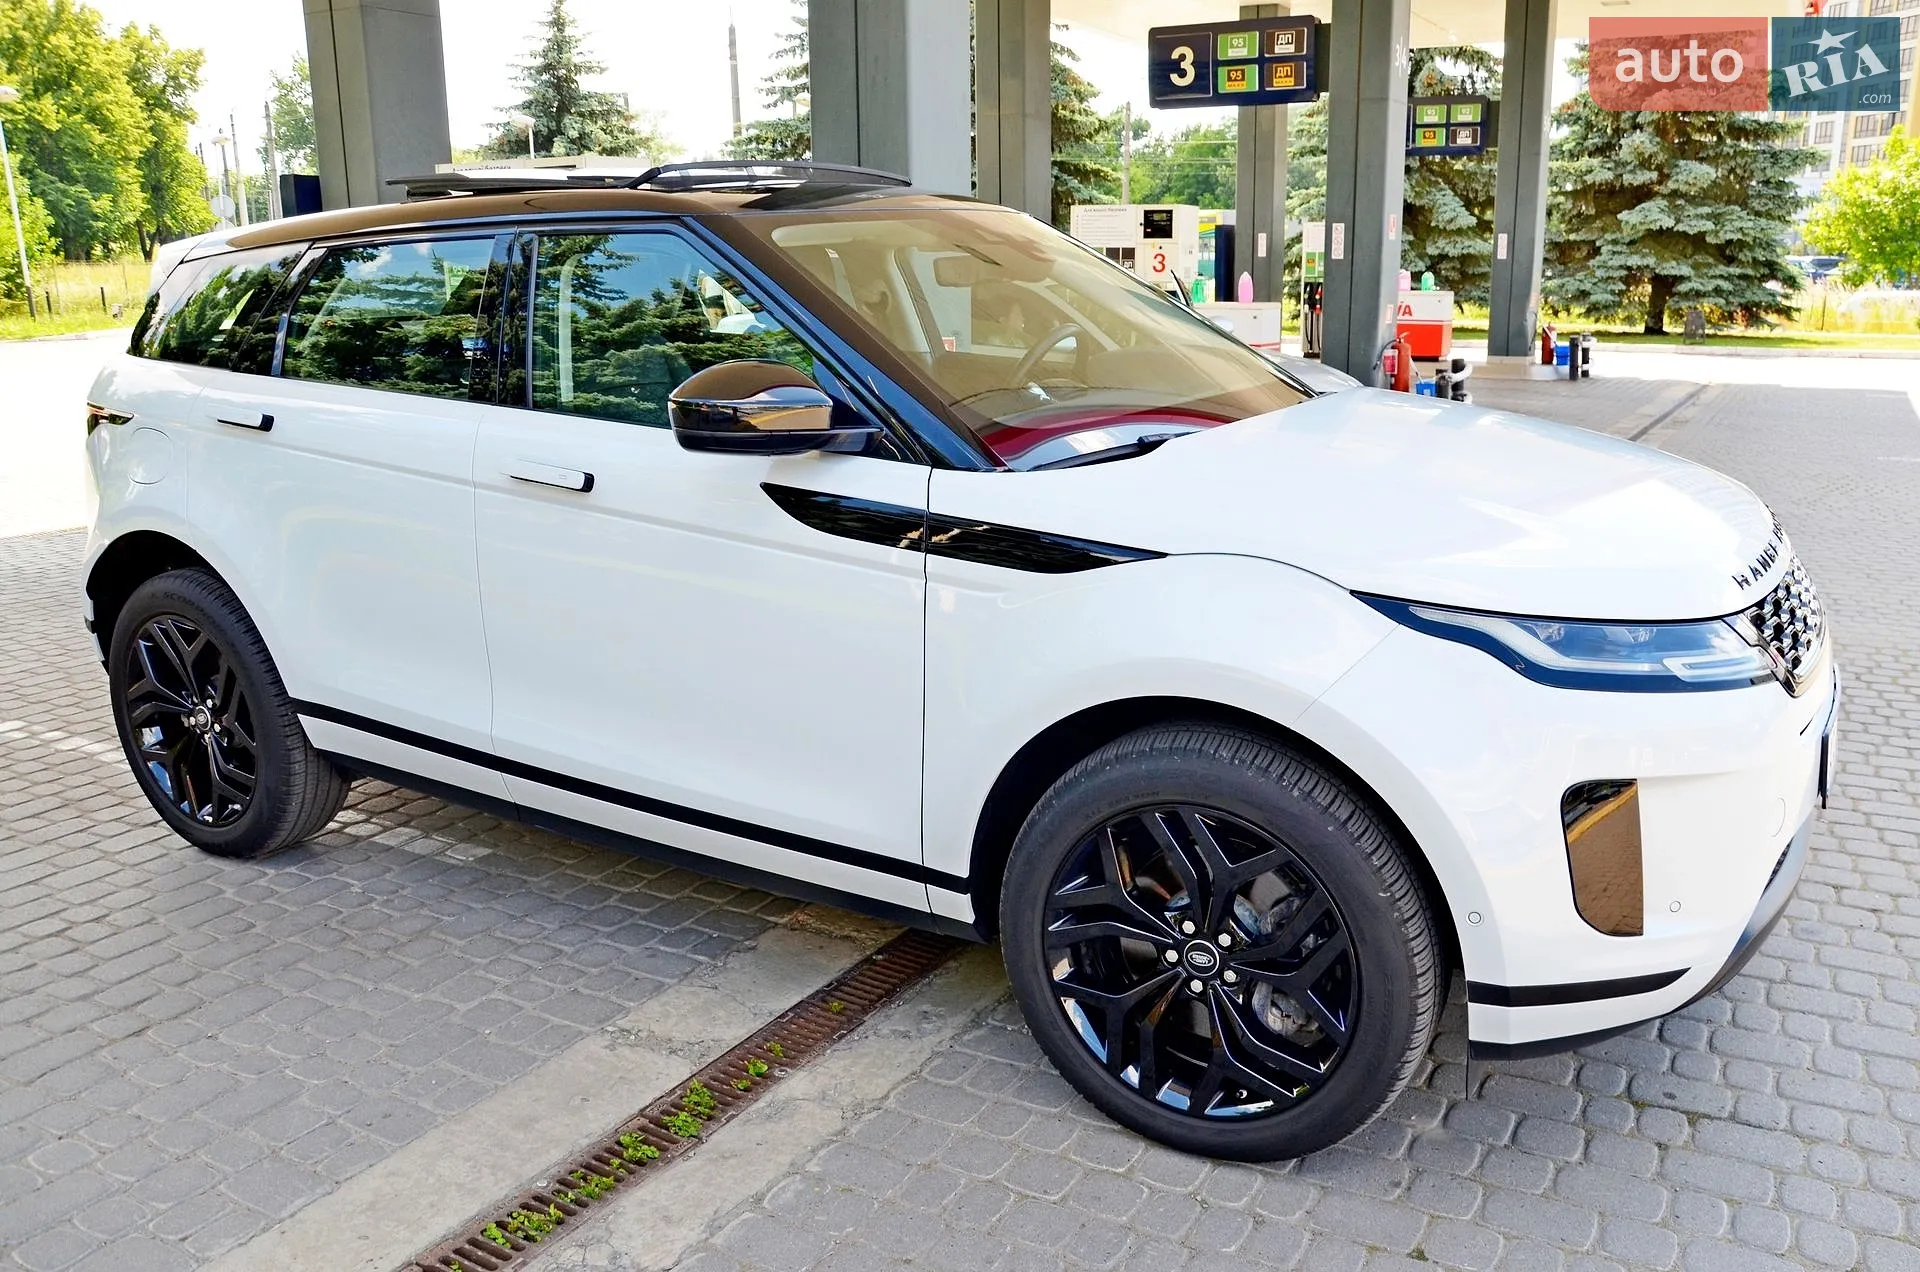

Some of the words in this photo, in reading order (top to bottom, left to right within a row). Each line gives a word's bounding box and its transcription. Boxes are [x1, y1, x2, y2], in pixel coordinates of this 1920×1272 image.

[1232, 38, 1244, 47] 95
[1277, 34, 1292, 46] ДП
[1169, 46, 1196, 87] 3
[1230, 70, 1242, 80] 95
[1275, 67, 1291, 78] ДП
[1152, 253, 1166, 273] 3
